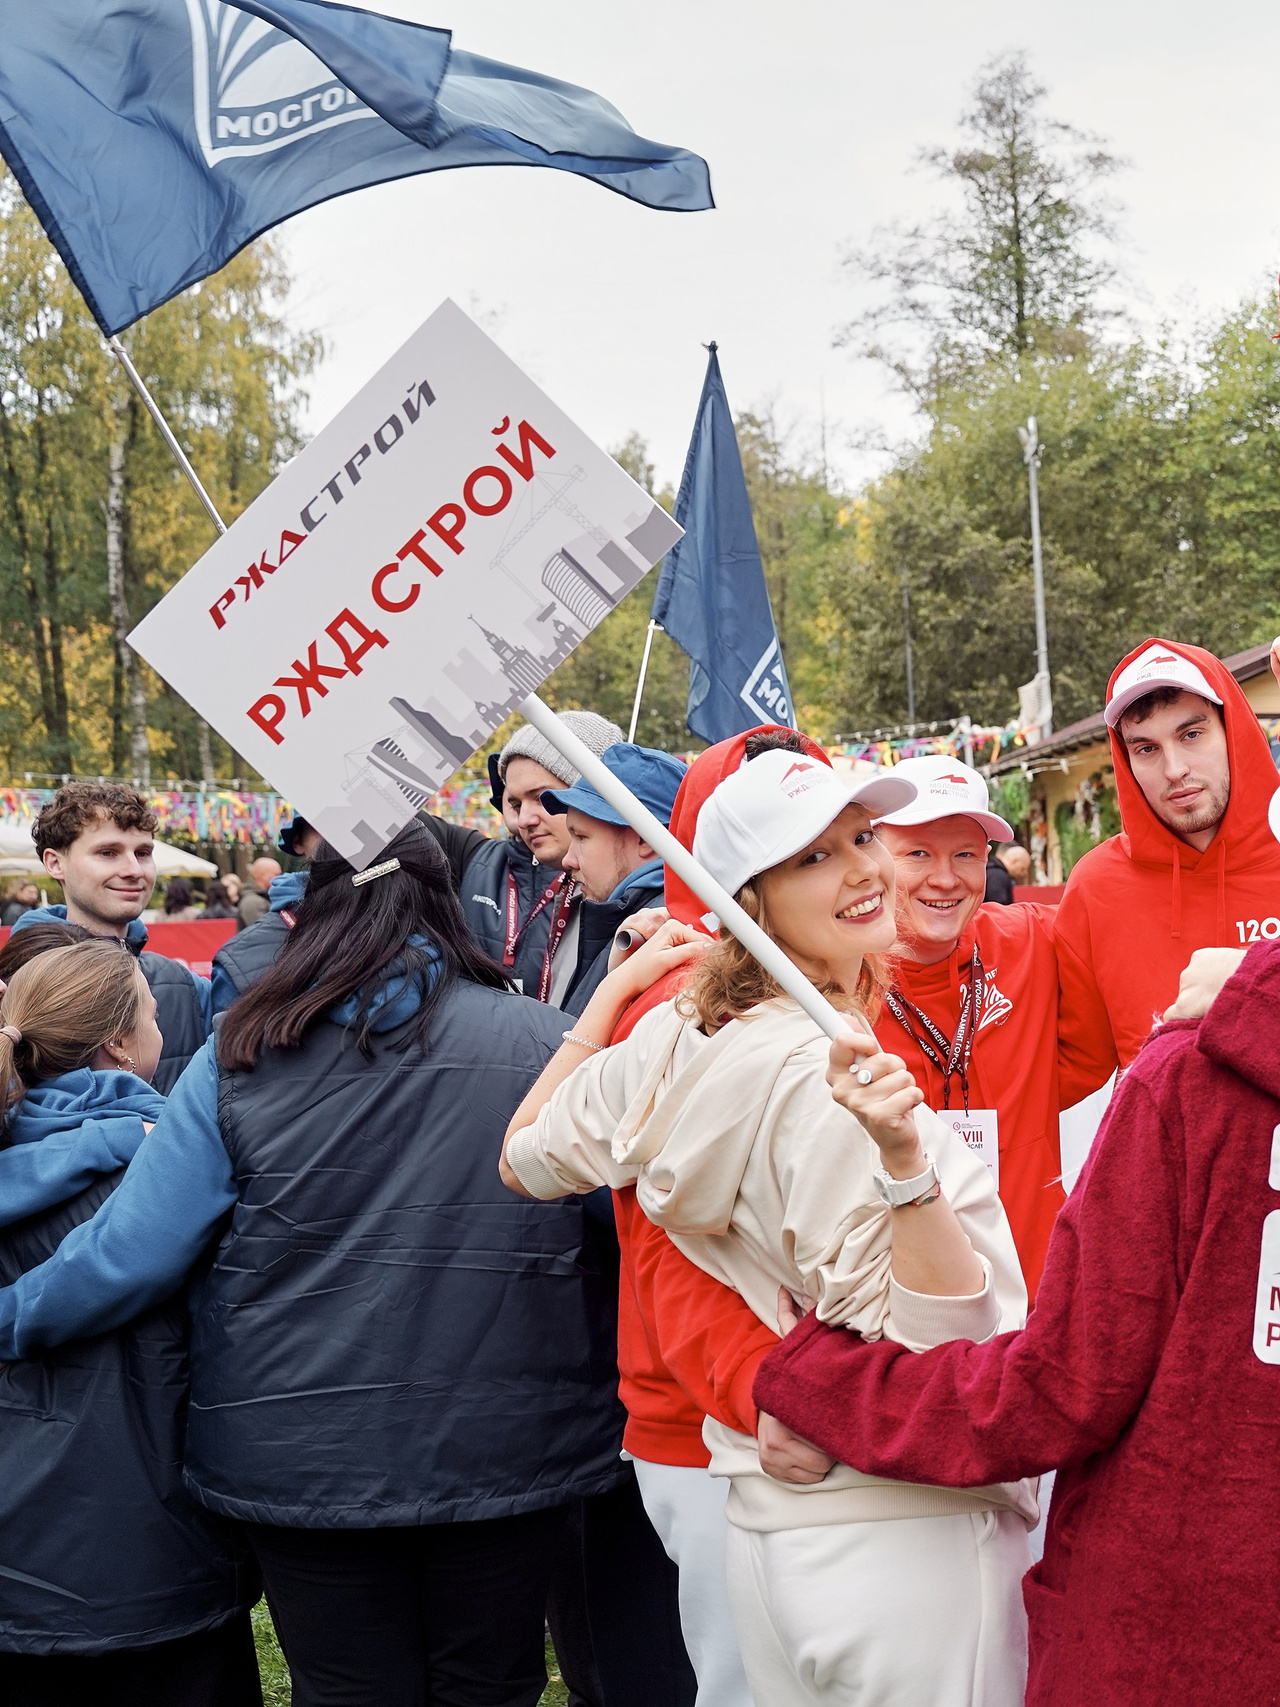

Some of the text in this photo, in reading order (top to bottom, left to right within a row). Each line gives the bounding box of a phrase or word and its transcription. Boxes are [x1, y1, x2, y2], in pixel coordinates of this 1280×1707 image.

[246, 415, 557, 745] РЖД СТРОЙ
[756, 677, 789, 721] МО
[958, 1131, 983, 1142] VIII
